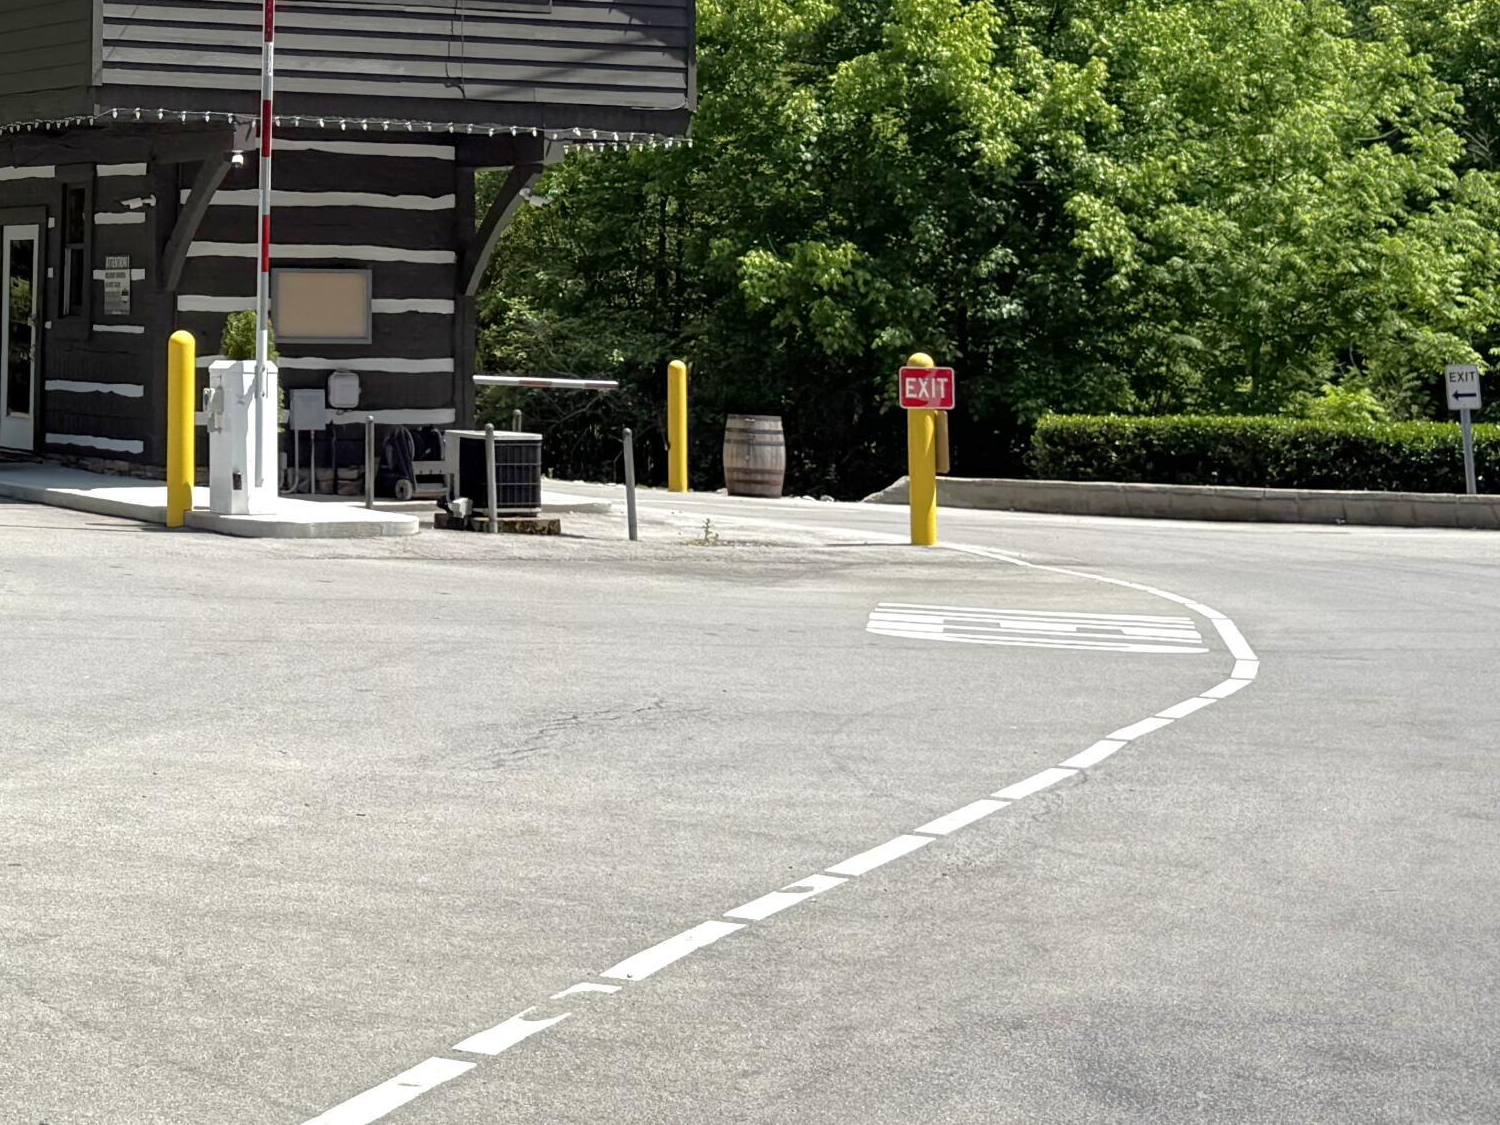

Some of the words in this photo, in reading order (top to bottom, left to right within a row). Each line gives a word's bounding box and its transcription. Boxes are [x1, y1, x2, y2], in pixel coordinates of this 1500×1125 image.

[904, 377, 949, 399] EXIT
[1448, 371, 1476, 383] EXIT
[865, 601, 1210, 654] YIELD
